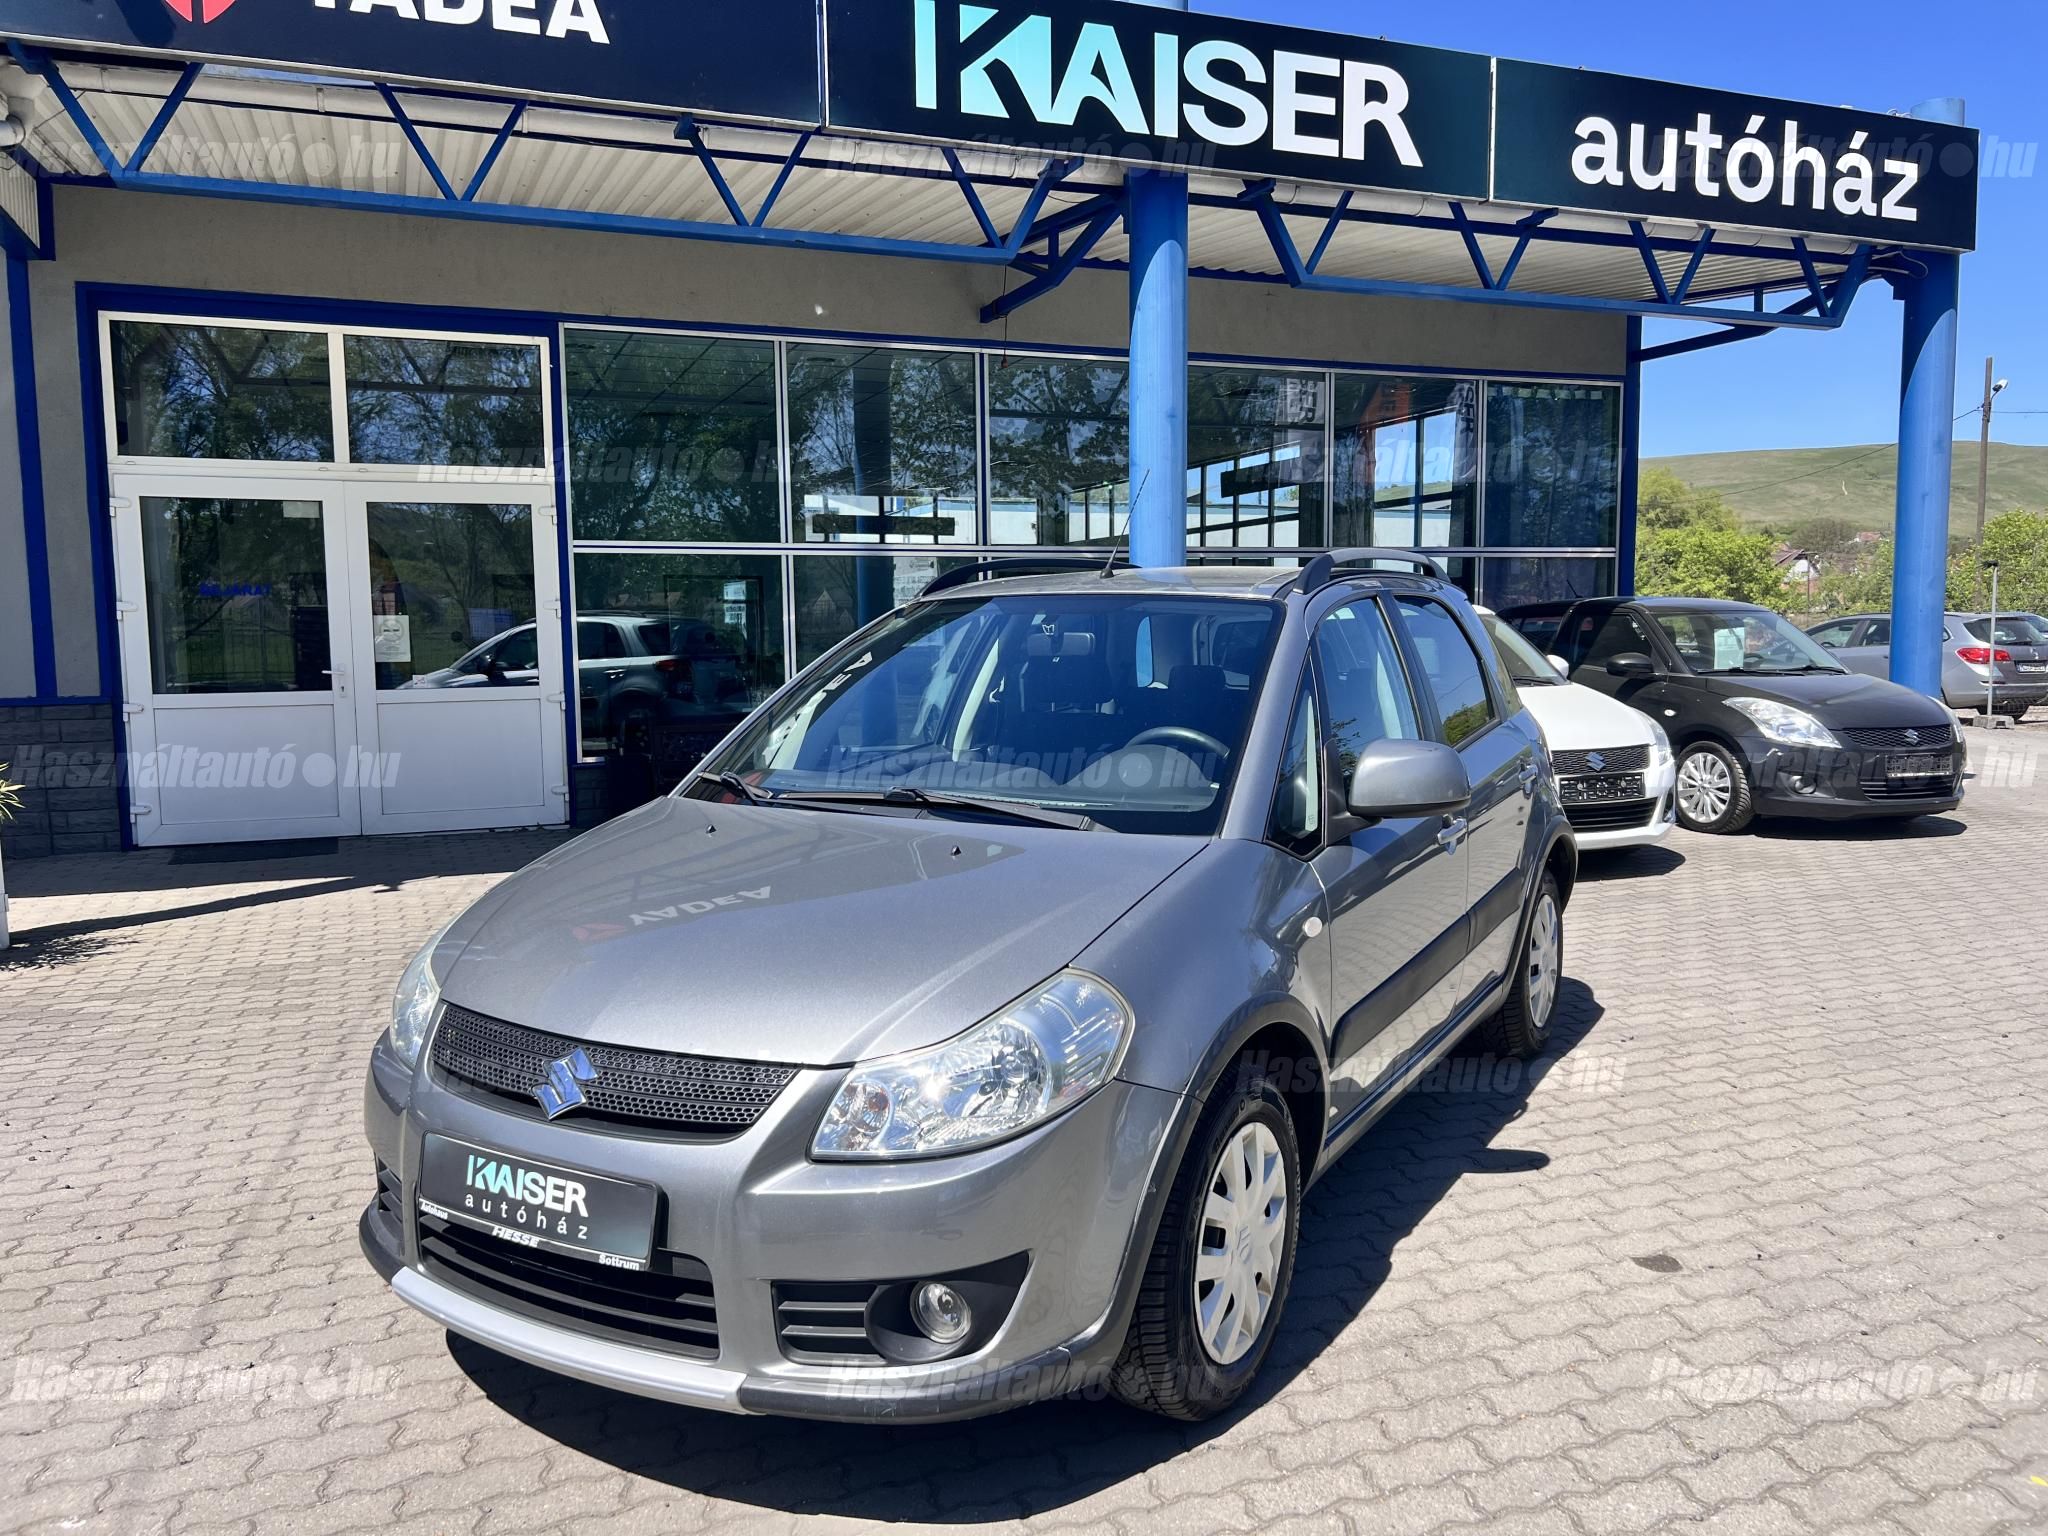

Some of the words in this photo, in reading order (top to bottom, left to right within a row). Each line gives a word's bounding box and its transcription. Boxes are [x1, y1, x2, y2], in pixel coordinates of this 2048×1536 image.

[915, 0, 1423, 168] KAISER
[1570, 112, 1920, 222] autóház
[465, 1154, 589, 1218] KAISER
[598, 1253, 641, 1272] Sottrum
